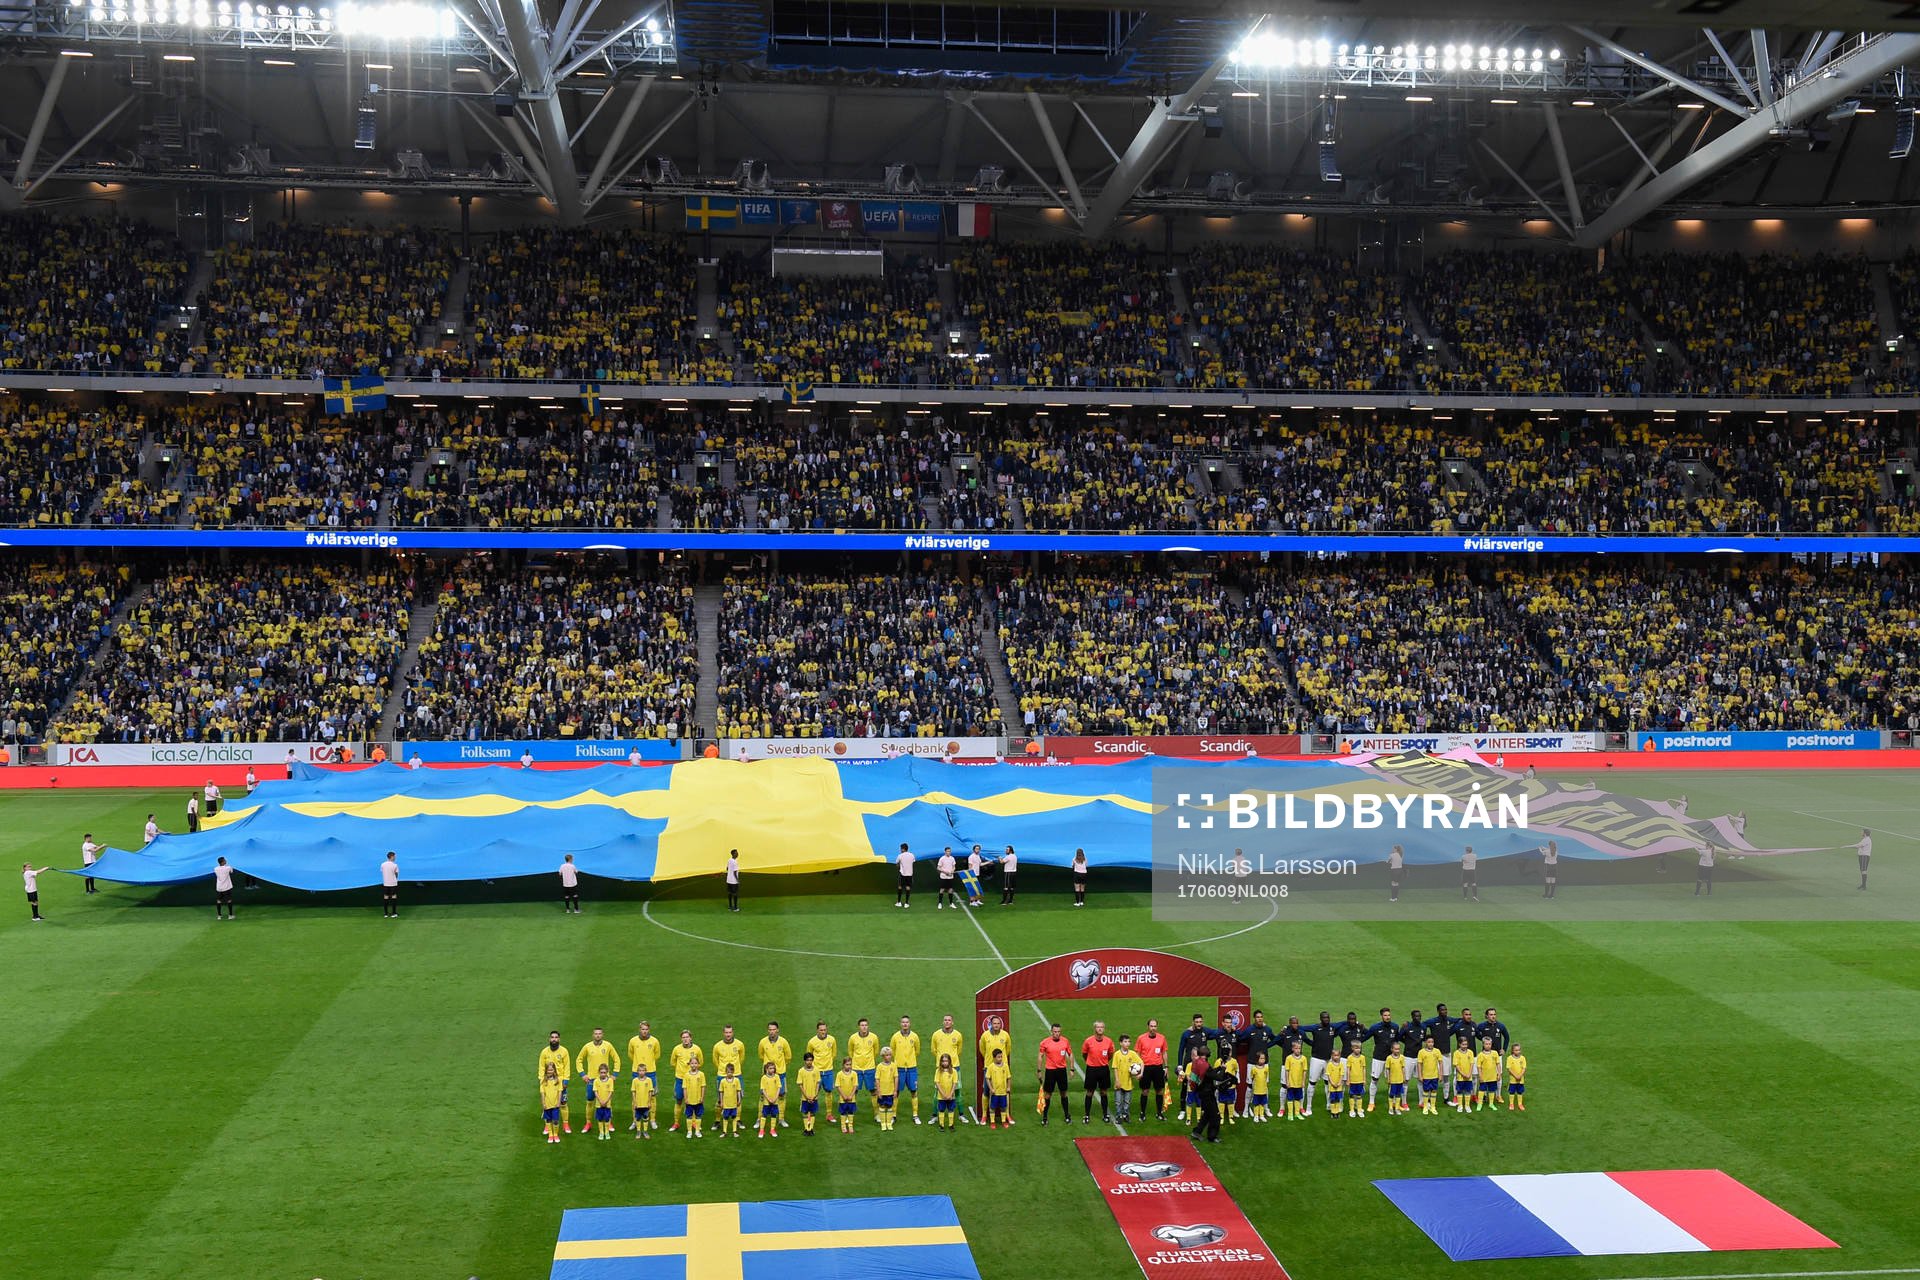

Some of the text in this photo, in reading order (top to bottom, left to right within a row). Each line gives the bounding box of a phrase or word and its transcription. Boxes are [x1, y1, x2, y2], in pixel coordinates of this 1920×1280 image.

[745, 203, 771, 214] FIFA
[864, 211, 897, 222] UEFA
[306, 533, 398, 548] #viärsverige
[905, 536, 990, 550] #viärsverige
[1464, 538, 1544, 552] #viärsverige
[1200, 740, 1252, 752] Scandic
[1489, 738, 1563, 749] INTERSPORT
[1664, 734, 1732, 749] postnord
[1787, 734, 1855, 748] postnord
[461, 746, 511, 757] Folksam
[575, 745, 625, 757] Folksam
[767, 744, 832, 754] Swedbank
[1094, 741, 1146, 753] Scandic
[70, 747, 100, 763] ICA
[152, 746, 252, 762] ica.se/hälsa
[1106, 965, 1153, 974] EUROPEAN
[1100, 974, 1159, 985] QUALIFIERS
[1110, 1185, 1217, 1195] QUALIFIERS
[1118, 1181, 1202, 1189] EUROPEAN
[1156, 1248, 1249, 1257] EUROPEAN
[1147, 1254, 1265, 1265] QUALIFIERS
